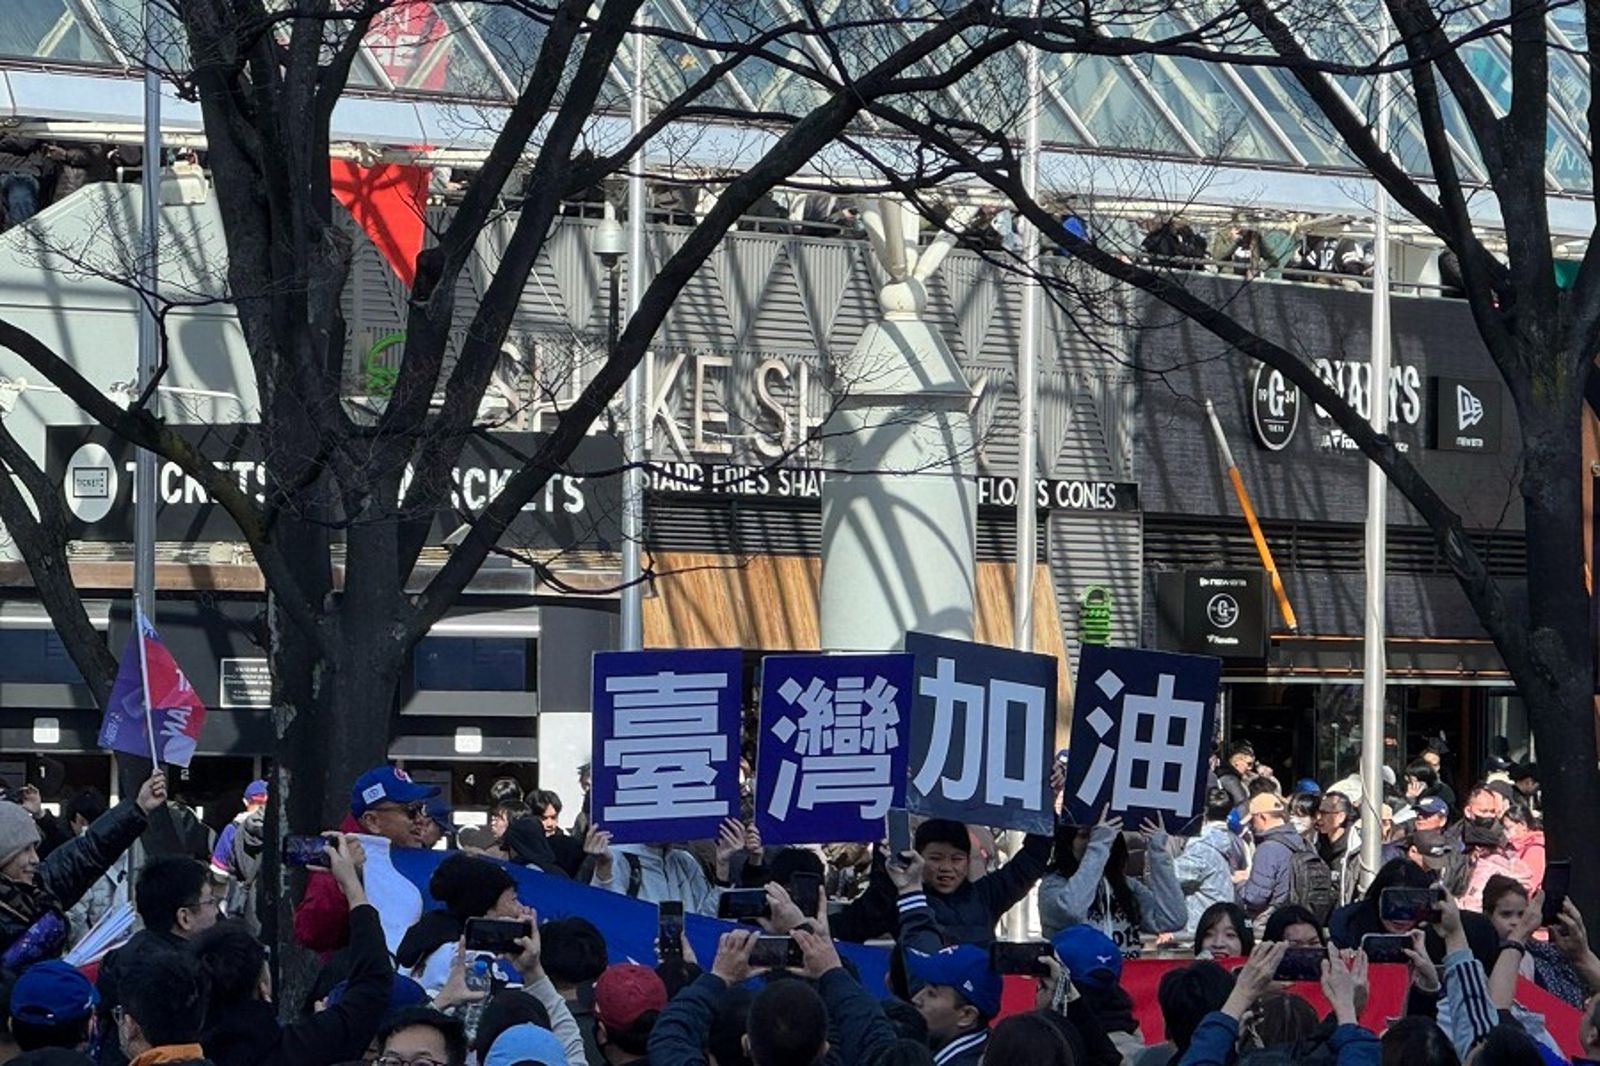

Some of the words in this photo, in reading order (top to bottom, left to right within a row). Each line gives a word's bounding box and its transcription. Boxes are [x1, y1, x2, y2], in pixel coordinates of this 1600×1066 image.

[1268, 369, 1285, 416] G
[712, 464, 770, 495] FRIES
[1055, 480, 1116, 510] CONES
[465, 773, 475, 786] 4
